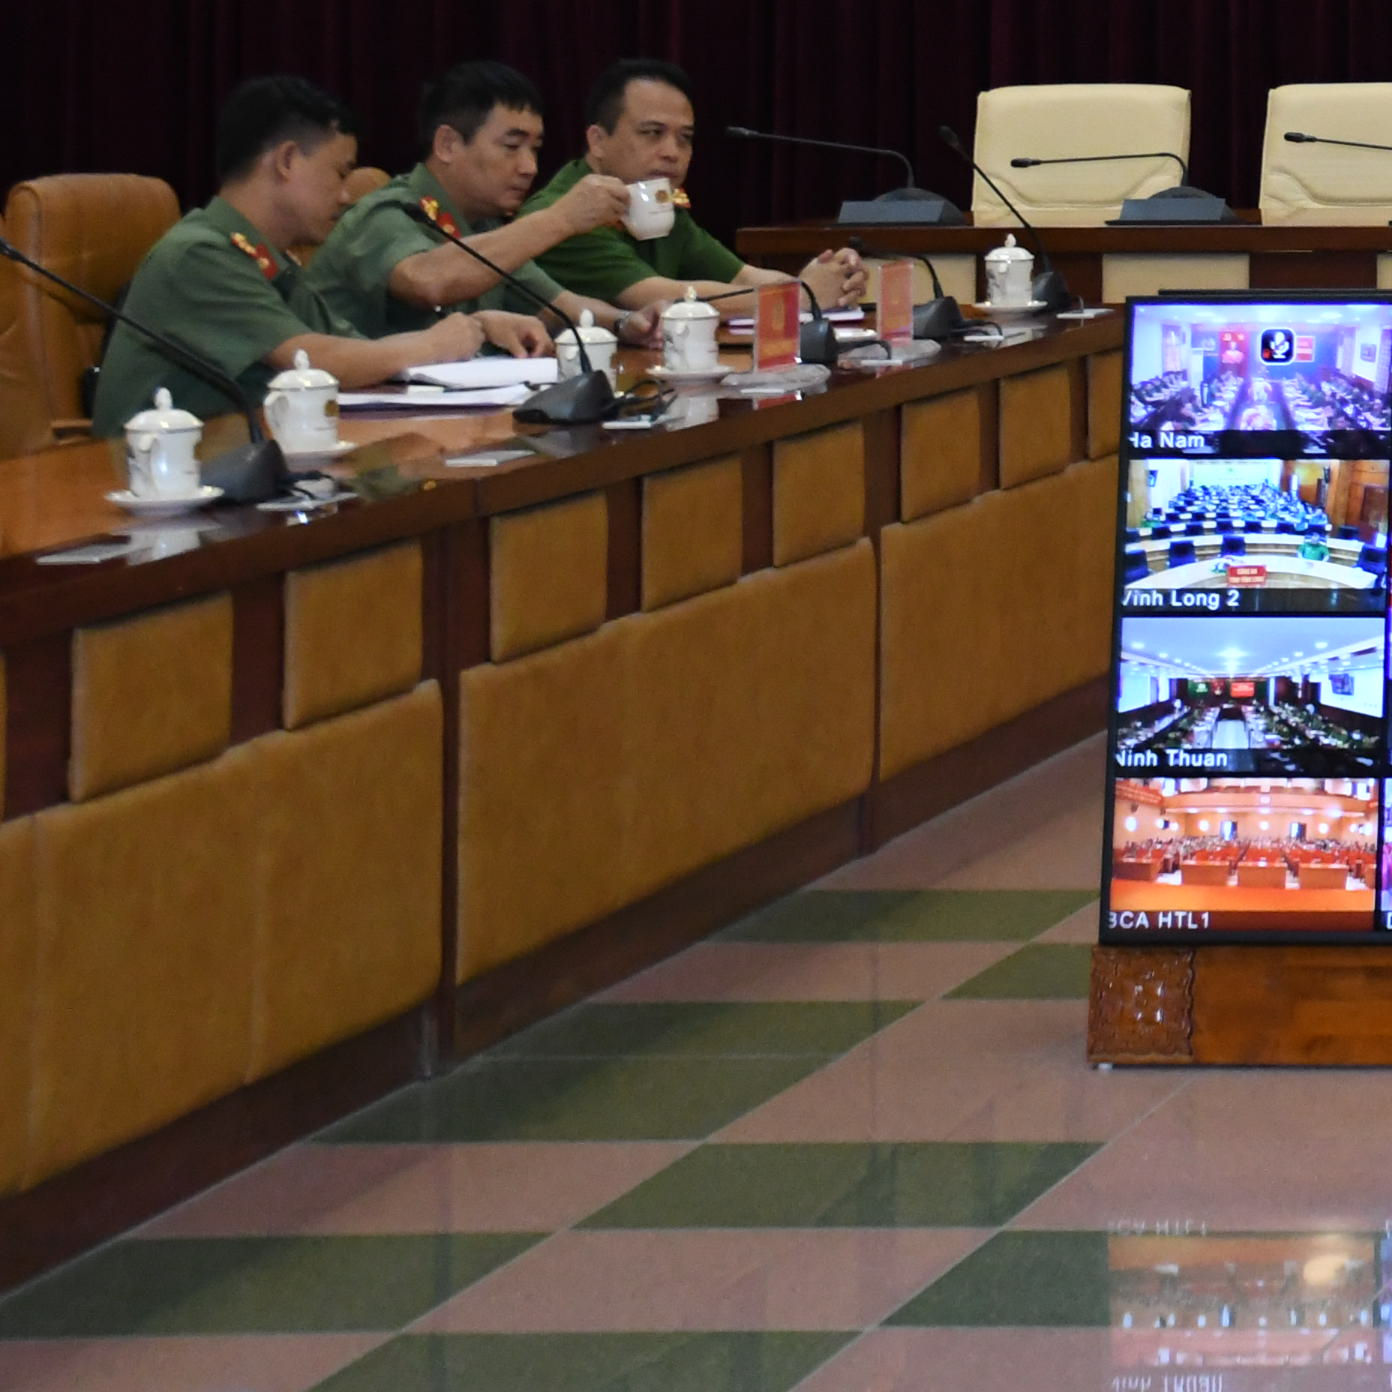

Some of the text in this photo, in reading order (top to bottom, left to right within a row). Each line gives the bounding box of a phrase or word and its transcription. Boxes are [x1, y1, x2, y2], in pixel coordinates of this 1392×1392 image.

[1160, 431, 1205, 448] Nam
[1170, 589, 1221, 611] Long
[1226, 589, 1240, 607] 2
[1165, 749, 1228, 767] Thuan
[1158, 910, 1210, 929] HTL1
